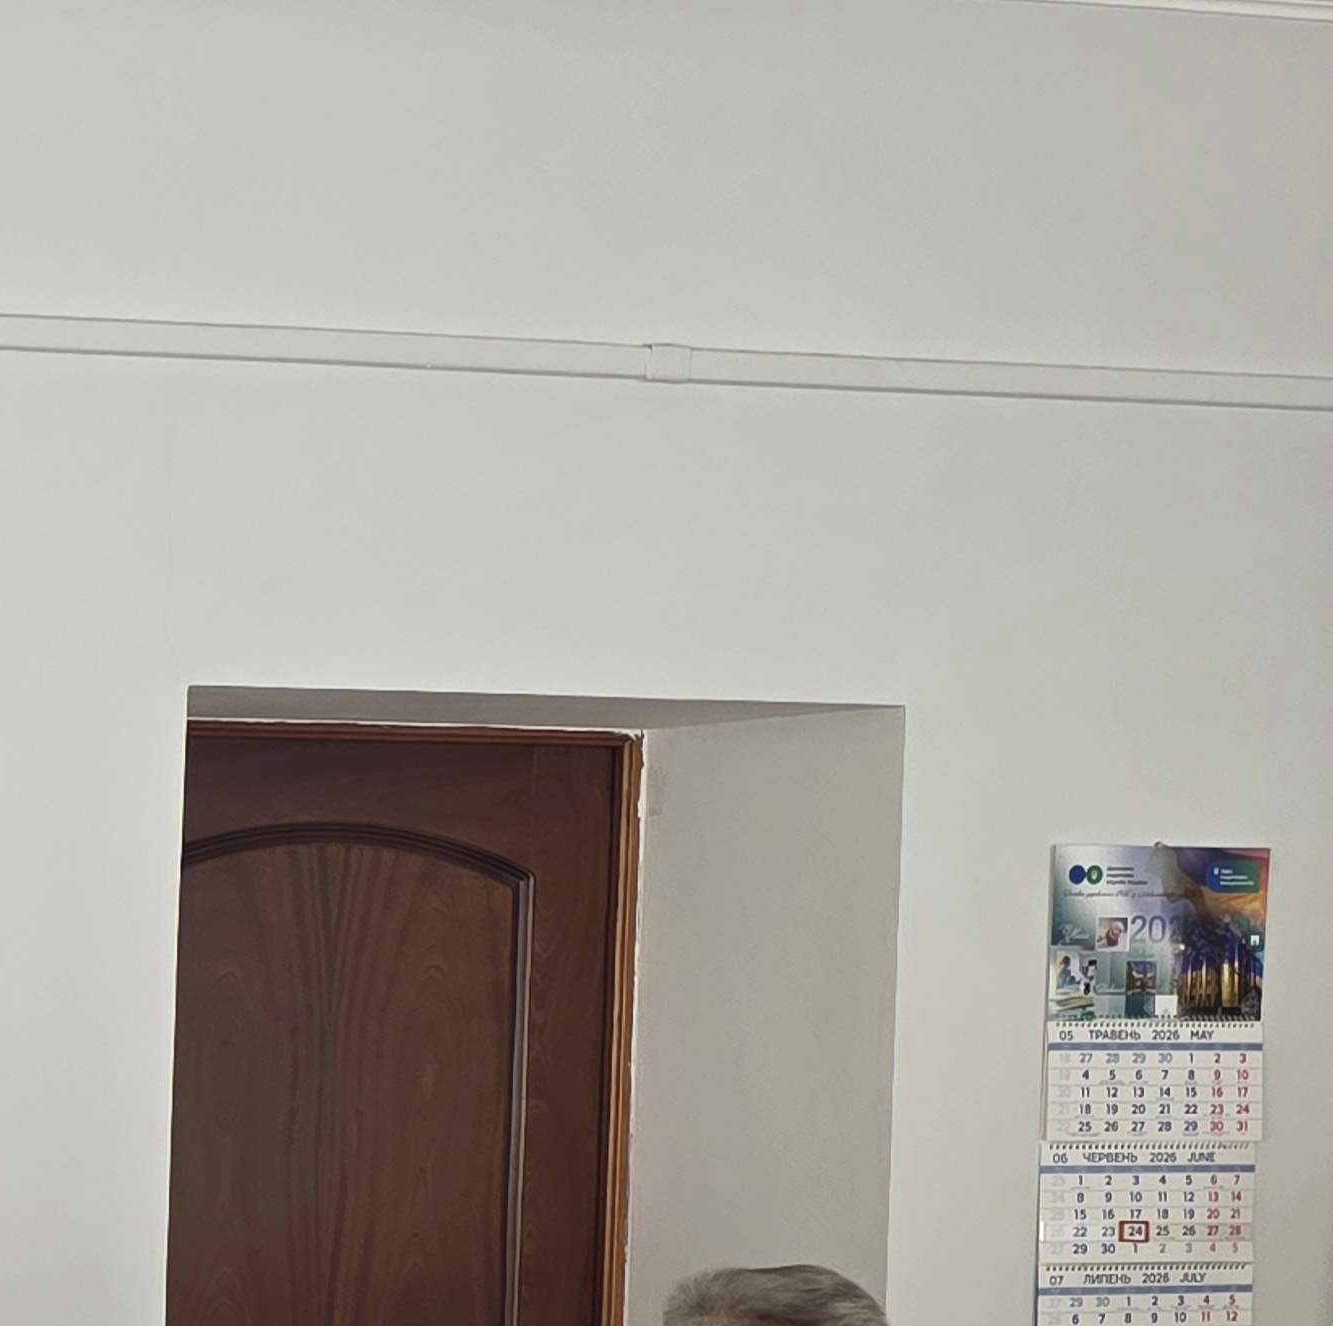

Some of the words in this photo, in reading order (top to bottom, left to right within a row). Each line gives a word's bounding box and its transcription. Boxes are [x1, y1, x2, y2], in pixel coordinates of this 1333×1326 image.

[1059, 1031, 1073, 1041] 05
[1089, 1030, 1141, 1040] ТРАВЕНЬ
[1152, 1030, 1180, 1040] 2026
[1190, 1030, 1214, 1040] MAY
[1081, 1088, 1090, 1097] 11
[1107, 1087, 1118, 1097] 12
[1133, 1087, 1144, 1097] 13
[1159, 1087, 1170, 1097] 14
[1185, 1087, 1197, 1097] 15
[1211, 1087, 1223, 1097] 16
[1237, 1087, 1248, 1097] 17
[1053, 1153, 1067, 1163] 06
[1083, 1153, 1138, 1163] ЧЕРВЕНЬ
[1150, 1153, 1177, 1162] 2026
[1187, 1152, 1215, 1162] JUNE
[1073, 1227, 1087, 1237] 22
[1102, 1227, 1115, 1237] 23
[1129, 1227, 1142, 1236] 24
[1156, 1226, 1169, 1236] 25
[1182, 1226, 1196, 1236] 26
[1207, 1226, 1219, 1235] 27
[1230, 1225, 1241, 1235] 28
[1050, 1276, 1063, 1286] 07
[1083, 1274, 1131, 1284] ЛИПЕНЬ
[1142, 1274, 1169, 1283] 2026
[1180, 1273, 1206, 1283] JULY
